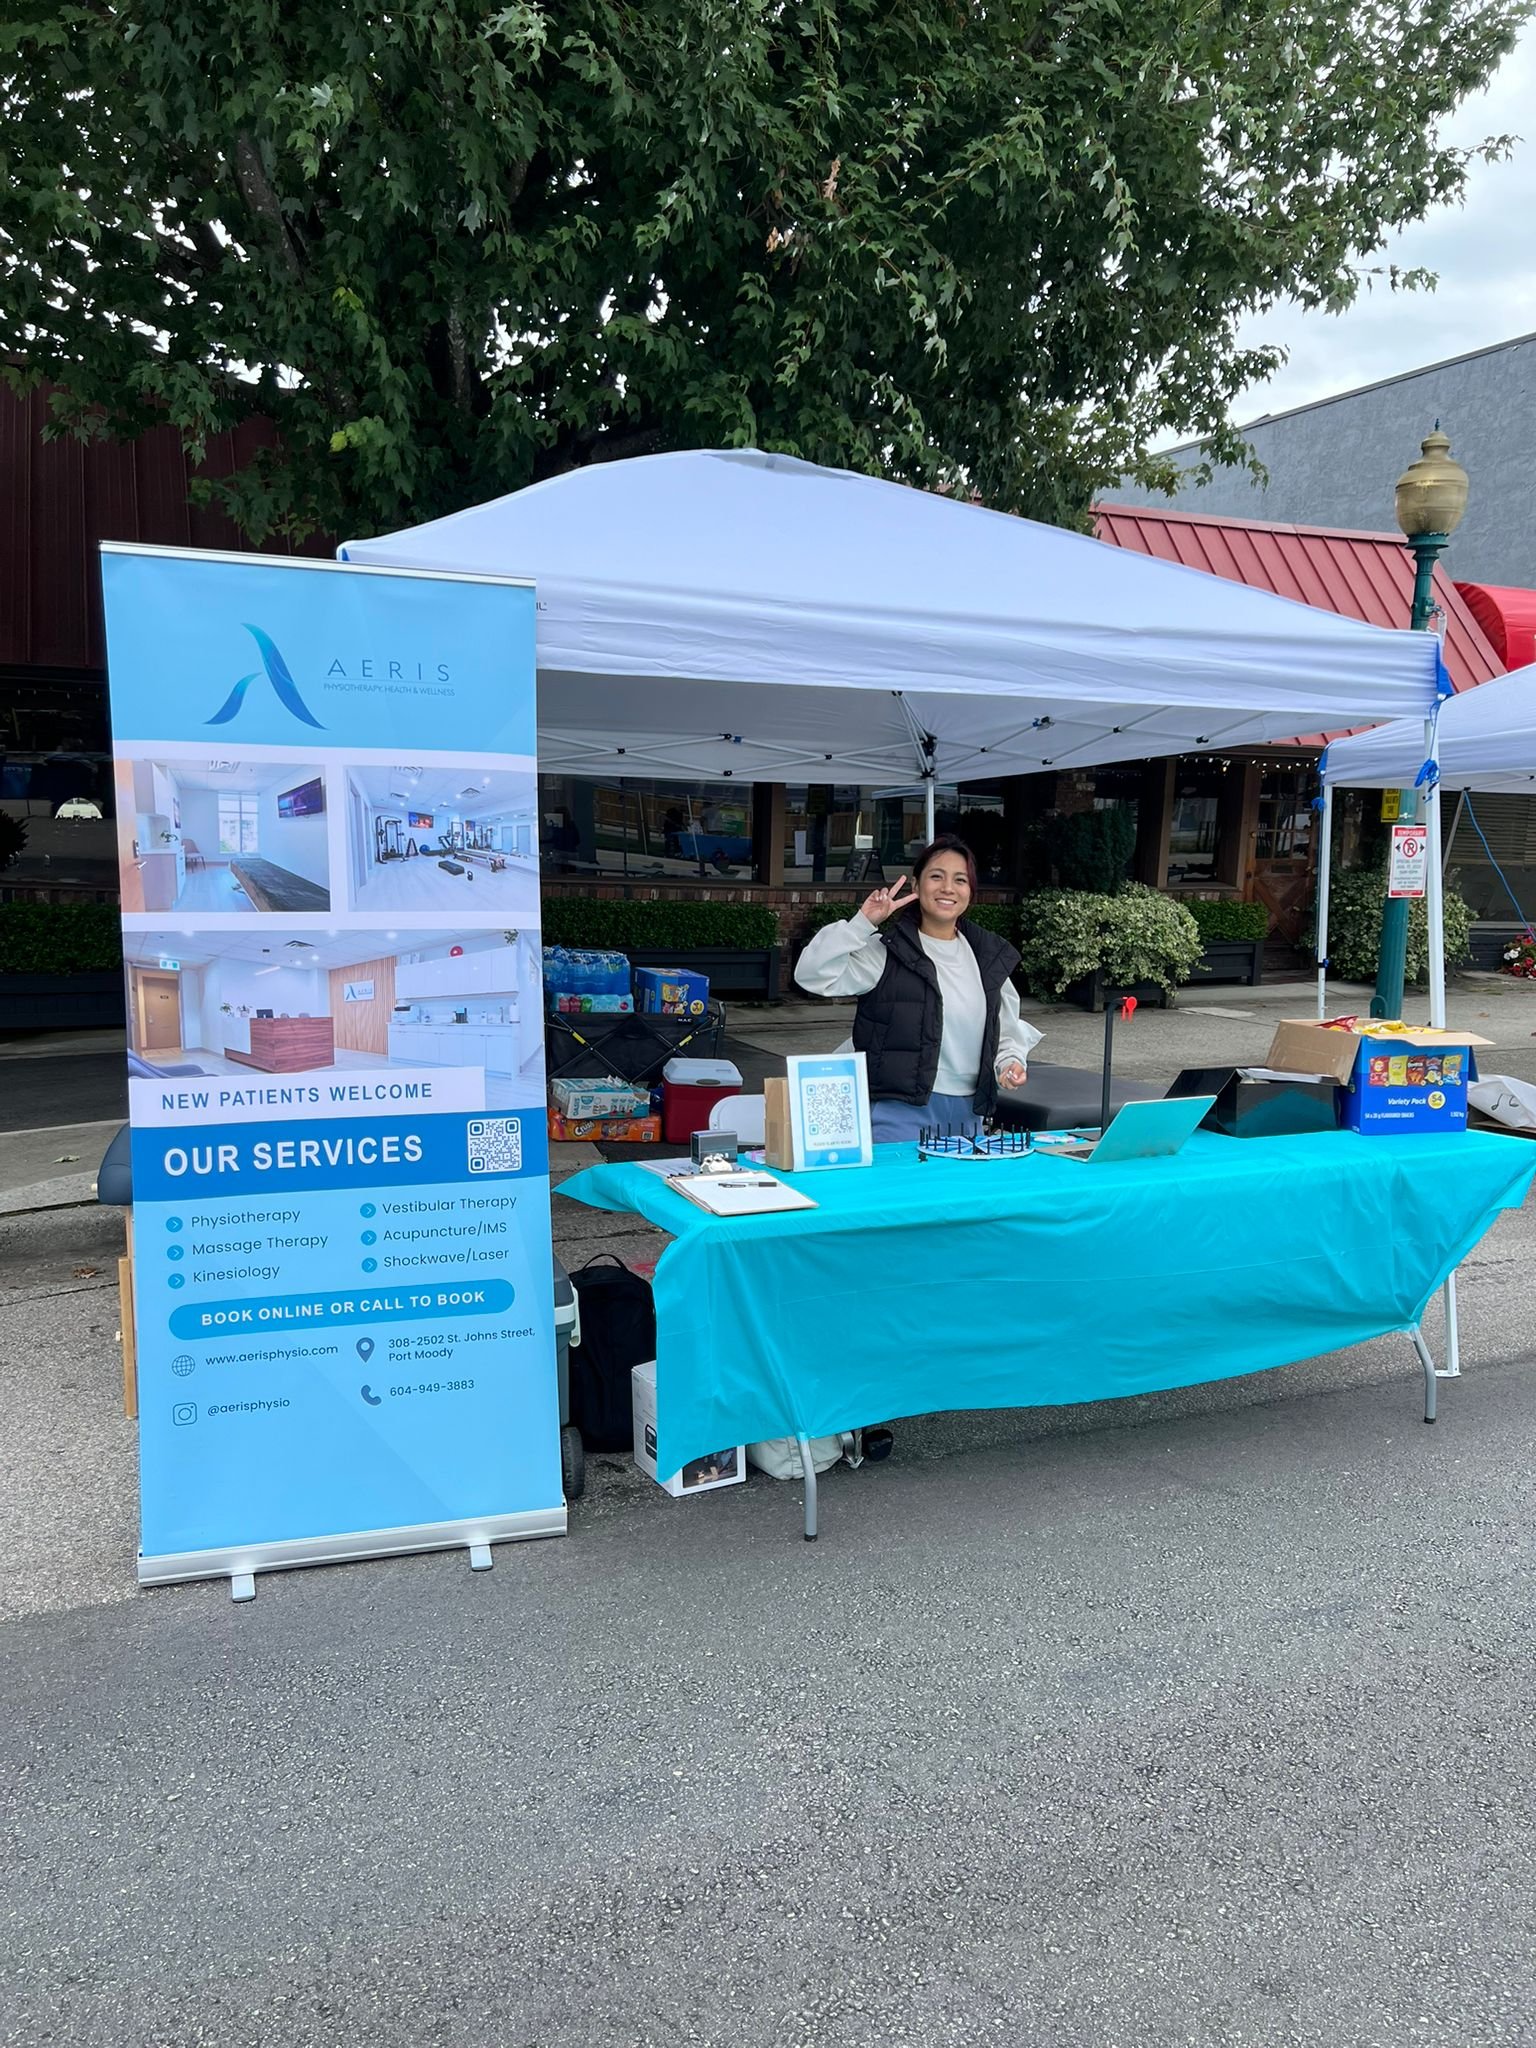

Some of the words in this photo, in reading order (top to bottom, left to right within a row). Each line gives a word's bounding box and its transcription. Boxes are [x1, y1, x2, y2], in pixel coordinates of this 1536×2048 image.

[327, 658, 450, 682] AERIS
[384, 685, 412, 695] HEALTH
[413, 687, 419, 695] &
[420, 687, 456, 697] WELLNESS
[162, 1092, 210, 1110] NEW
[219, 1087, 320, 1107] PATIENTS
[329, 1082, 433, 1102] WELCOME
[1387, 1098, 1410, 1106] Variety
[1431, 1094, 1442, 1102] 54
[574, 1121, 596, 1137] Crush
[163, 1144, 240, 1177] OUR
[252, 1134, 423, 1171] SERVICES
[382, 1200, 456, 1215] Vestibular
[460, 1196, 517, 1210] Therapy
[191, 1210, 301, 1230] Physiotherapy
[383, 1221, 507, 1242] Acupuncture/IMS
[192, 1240, 262, 1255] Massage
[266, 1235, 329, 1249] Therapy
[383, 1248, 510, 1268] Shockwave/Laser
[193, 1265, 281, 1283] Kinesiology
[201, 1309, 253, 1326] BOOK
[258, 1303, 324, 1320] ONLINE
[330, 1299, 355, 1314] OR
[360, 1297, 404, 1312] CALL
[409, 1295, 431, 1308] TO
[437, 1290, 485, 1306] BOOK
[388, 1334, 444, 1349] 308-2502
[447, 1333, 461, 1344] St.
[464, 1331, 498, 1343] Johns
[500, 1327, 536, 1340] Street,
[205, 1345, 339, 1366] www.aerisphysio.com
[388, 1352, 412, 1362] Port
[414, 1347, 454, 1360] Moody
[389, 1379, 475, 1397] 604-949-3883
[207, 1398, 291, 1417] @aerisphysio
